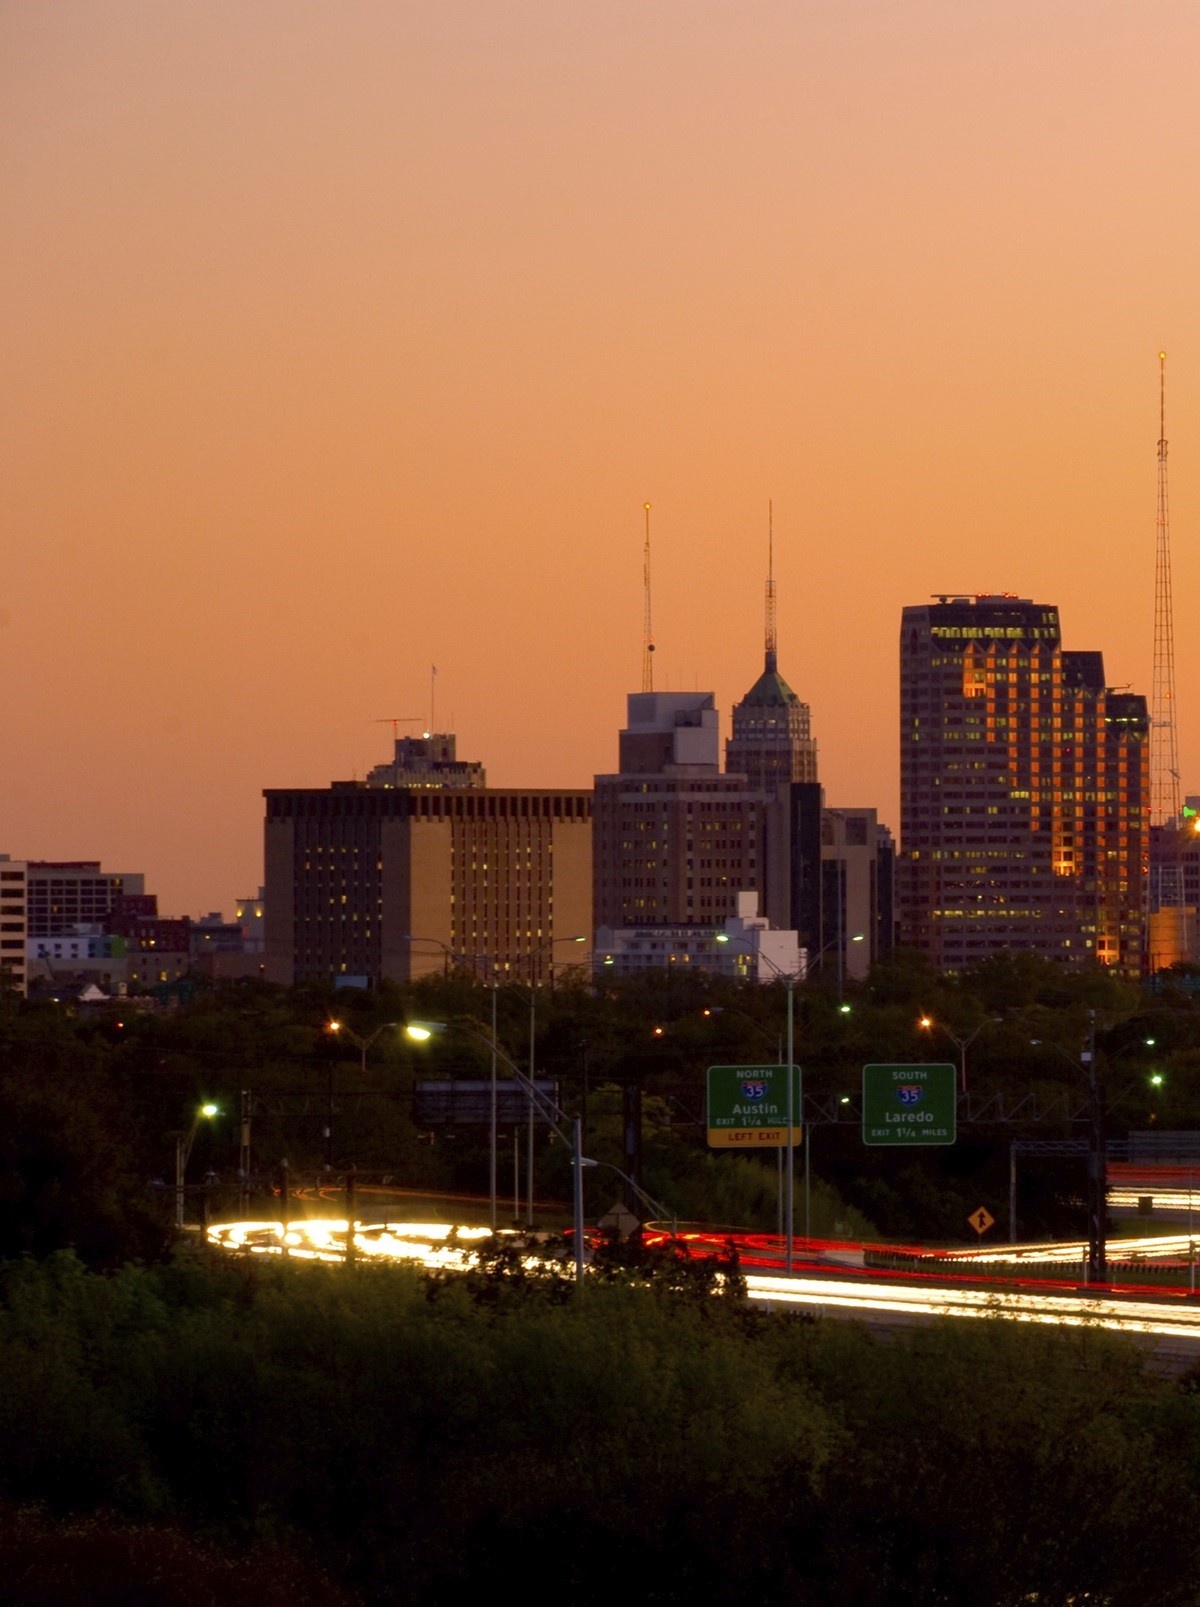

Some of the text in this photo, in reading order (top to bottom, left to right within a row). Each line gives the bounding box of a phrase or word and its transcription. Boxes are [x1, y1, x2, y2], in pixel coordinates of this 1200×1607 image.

[736, 1069, 773, 1078] NORTH
[892, 1071, 928, 1080] SOUTH
[746, 1086, 764, 1097] 35
[901, 1090, 919, 1102] 35
[733, 1104, 778, 1114] Austin
[716, 1117, 735, 1125] EXIT
[885, 1111, 934, 1122] Laredo
[728, 1131, 781, 1141] LEFT EXIT
[871, 1128, 890, 1136] EXIT
[922, 1128, 947, 1136] MILES
